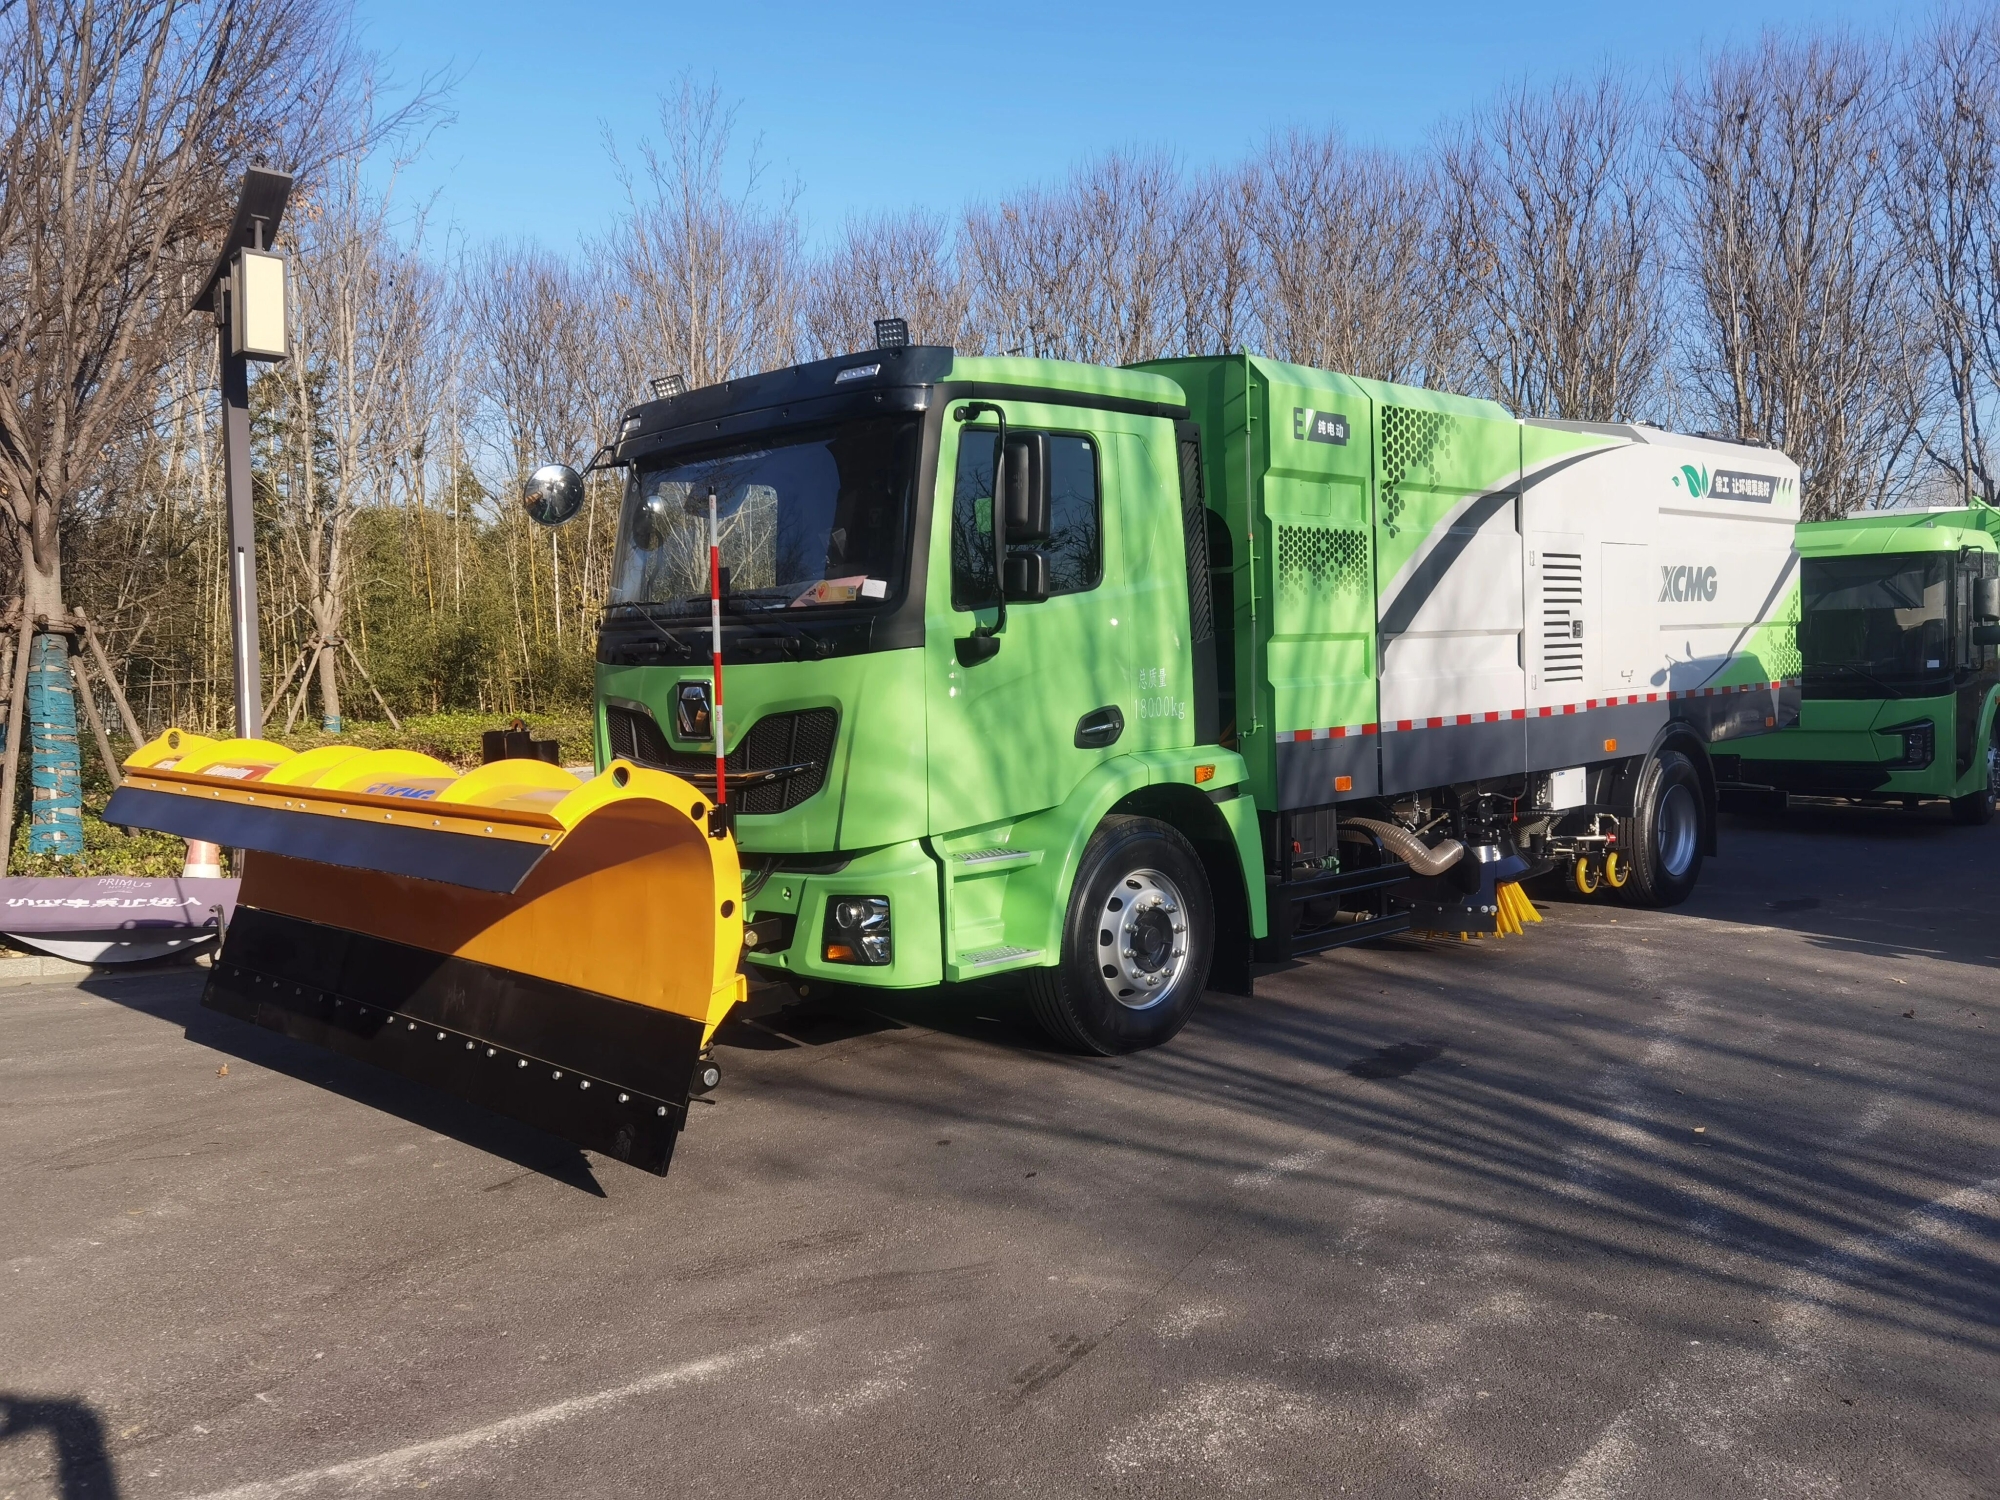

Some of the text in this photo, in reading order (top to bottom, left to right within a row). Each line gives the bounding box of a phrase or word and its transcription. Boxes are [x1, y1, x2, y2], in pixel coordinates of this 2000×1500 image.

[1317, 419, 1344, 438] 纯电动
[1715, 475, 1730, 494] 徐工
[1658, 565, 1718, 603] XCMG
[1138, 667, 1167, 690] 总质量
[1134, 695, 1185, 720] 18000kg
[97, 878, 152, 888] PRIMUS
